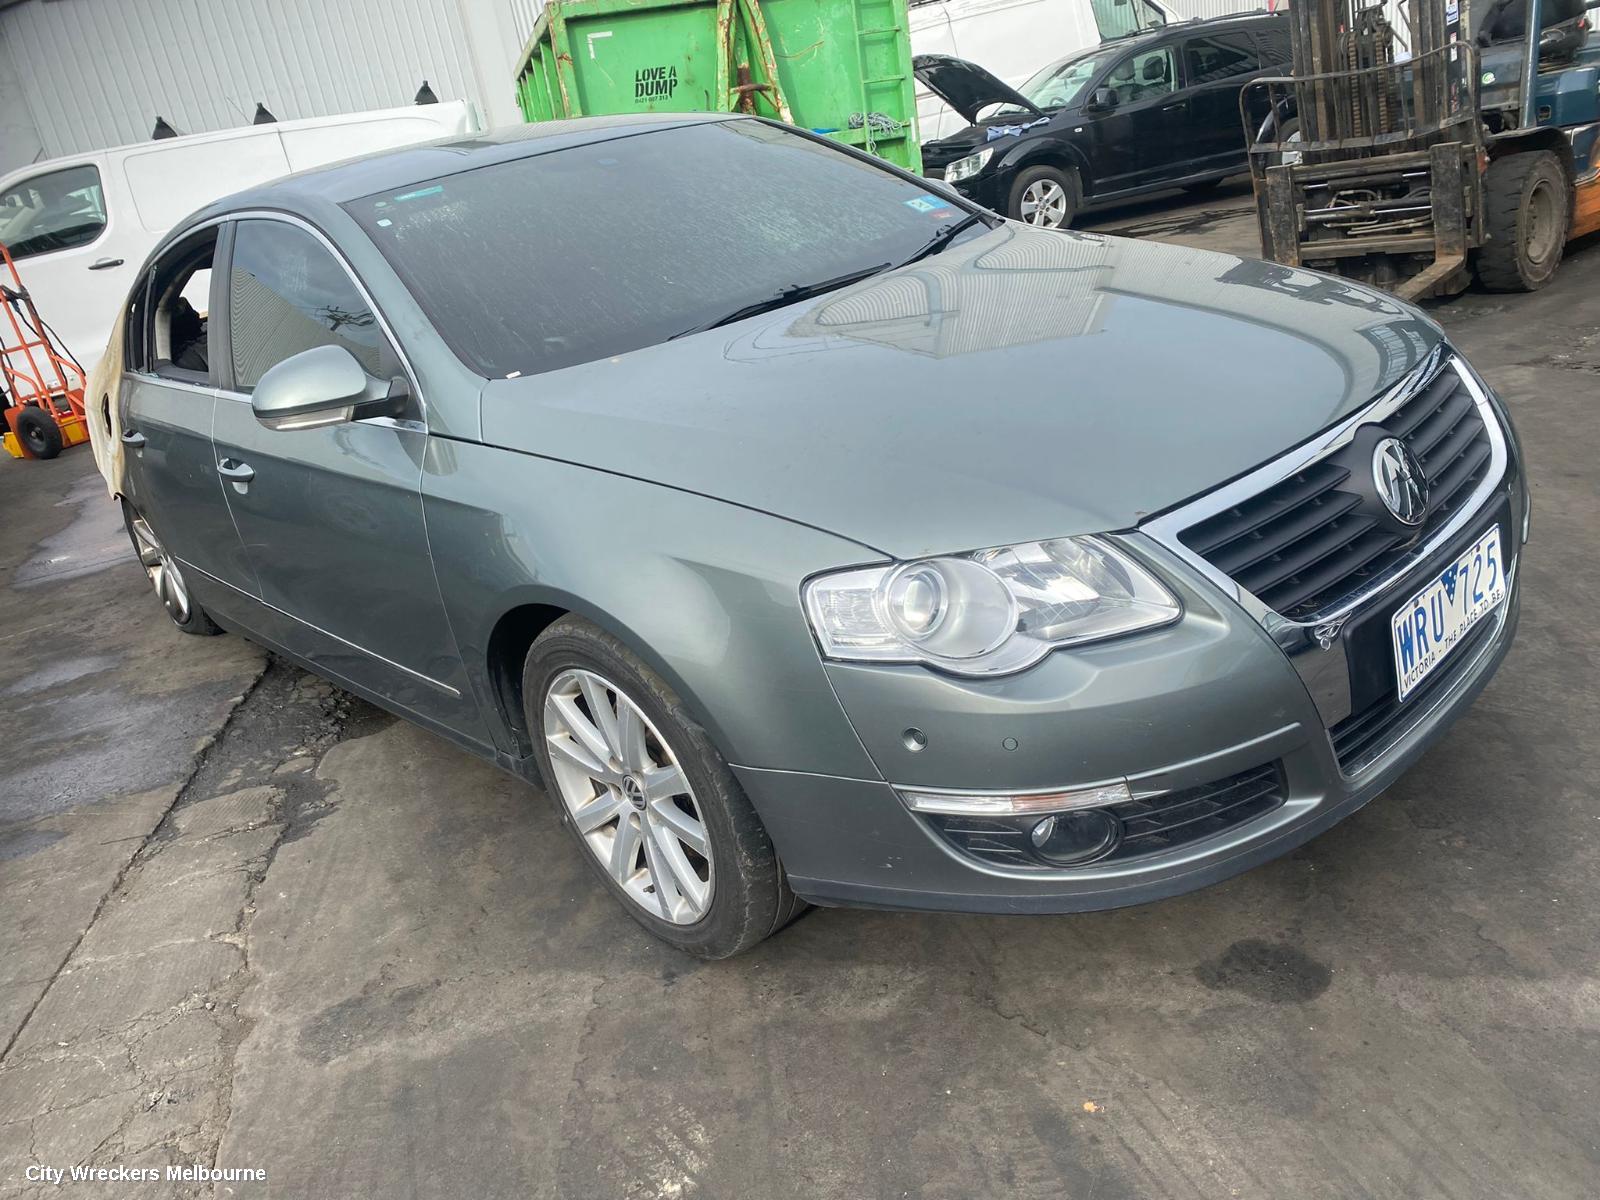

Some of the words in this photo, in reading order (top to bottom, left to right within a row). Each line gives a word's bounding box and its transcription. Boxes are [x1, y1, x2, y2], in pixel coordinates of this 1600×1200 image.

[635, 67, 666, 82] LOVE
[668, 65, 677, 78] A
[635, 79, 678, 98] DUMP
[1397, 590, 1445, 675] WRU
[1459, 540, 1497, 615] 725
[1403, 654, 1436, 687] VICTORIA
[1444, 630, 1457, 650] THE
[1459, 609, 1478, 634] PLACE
[1479, 599, 1489, 614] TO
[1492, 590, 1501, 604] BE
